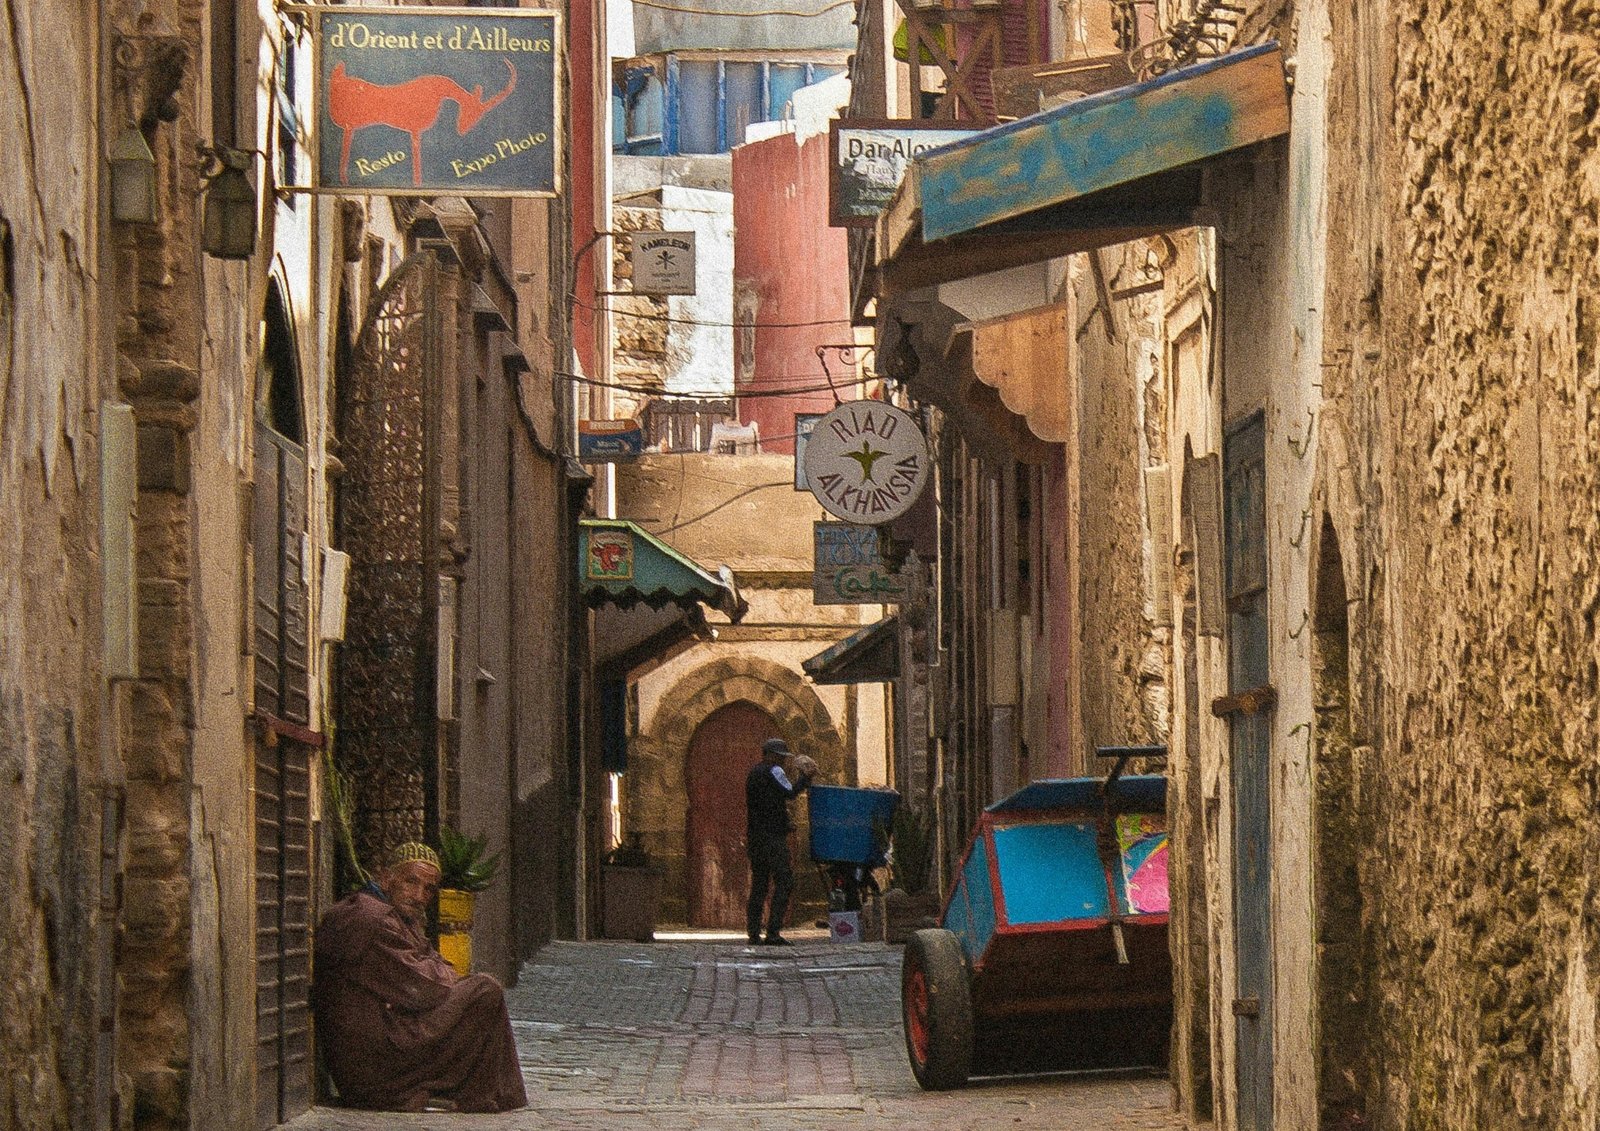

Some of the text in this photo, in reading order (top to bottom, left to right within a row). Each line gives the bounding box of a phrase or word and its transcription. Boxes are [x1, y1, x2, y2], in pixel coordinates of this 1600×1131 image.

[330, 23, 551, 52] d'Orient et d'Ailleurs
[450, 131, 548, 179] Expo Photo
[849, 138, 886, 158] Dar
[355, 150, 406, 178] Resto
[830, 409, 898, 443] RIAD
[816, 454, 920, 515] ALKHANSAA
